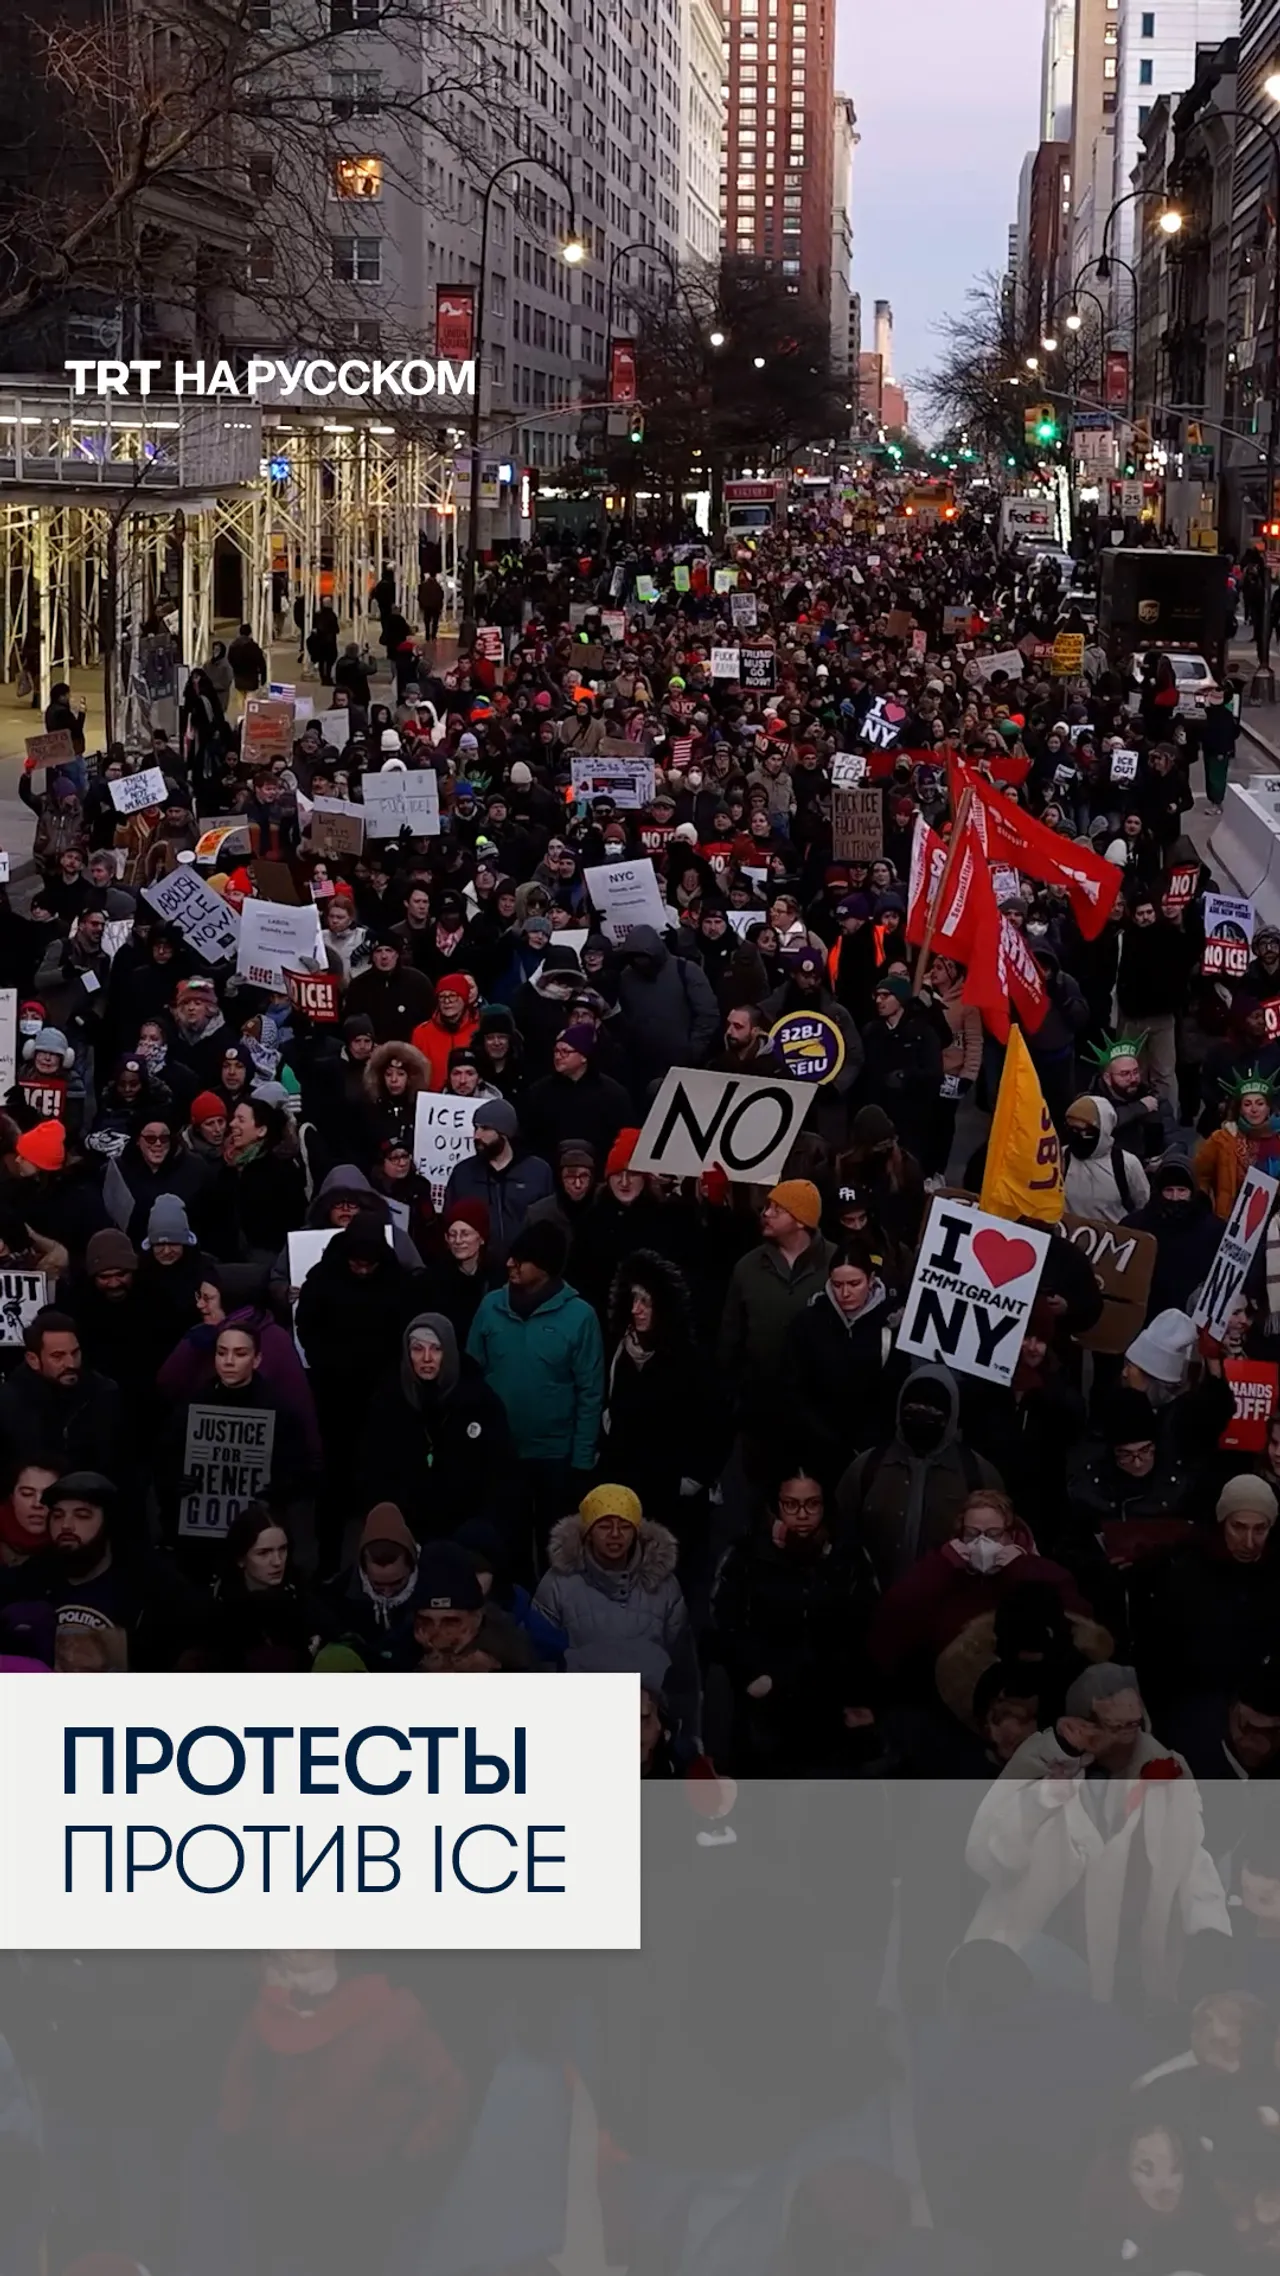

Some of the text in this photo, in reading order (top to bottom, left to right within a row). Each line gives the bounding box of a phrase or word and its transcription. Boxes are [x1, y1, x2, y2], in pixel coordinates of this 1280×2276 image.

[1124, 494, 1141, 505] 25
[1008, 508, 1049, 525] FedEx
[741, 649, 774, 659] TRUMP
[744, 659, 771, 668] MUST
[745, 676, 771, 686] NOW!
[750, 668, 765, 677] GO
[870, 696, 887, 717] I
[860, 718, 898, 748] NY
[1113, 765, 1134, 775] OUT
[1117, 756, 1134, 766] ICE
[124, 792, 158, 811] MURDER
[130, 789, 147, 799] NOT
[835, 792, 879, 813] FUCK ICE
[642, 832, 661, 849] NO
[609, 870, 635, 884] NYC
[1169, 873, 1191, 896] NO
[156, 873, 201, 916] ABOLISH
[173, 893, 221, 934] ICE
[268, 919, 290, 927] LABOR
[1221, 908, 1234, 917] NEW
[191, 907, 237, 948] NOW!
[1204, 944, 1248, 971] NO ICE!
[301, 982, 334, 1010] ICE!
[780, 1022, 823, 1043] 32BJ
[23, 1087, 62, 1117] ICE!
[428, 1106, 466, 1129] ICE
[650, 1080, 795, 1171] NO
[434, 1134, 476, 1153] OUT
[1229, 1182, 1255, 1239] I
[929, 1213, 973, 1275] I
[0, 1274, 41, 1302] UT
[918, 1268, 1028, 1316] IMMIGRANT
[1199, 1255, 1245, 1325] NY
[909, 1286, 1021, 1368] NY
[1228, 1380, 1274, 1399] HANDS
[193, 1418, 267, 1446] JUSTICE
[212, 1446, 242, 1463] FOR
